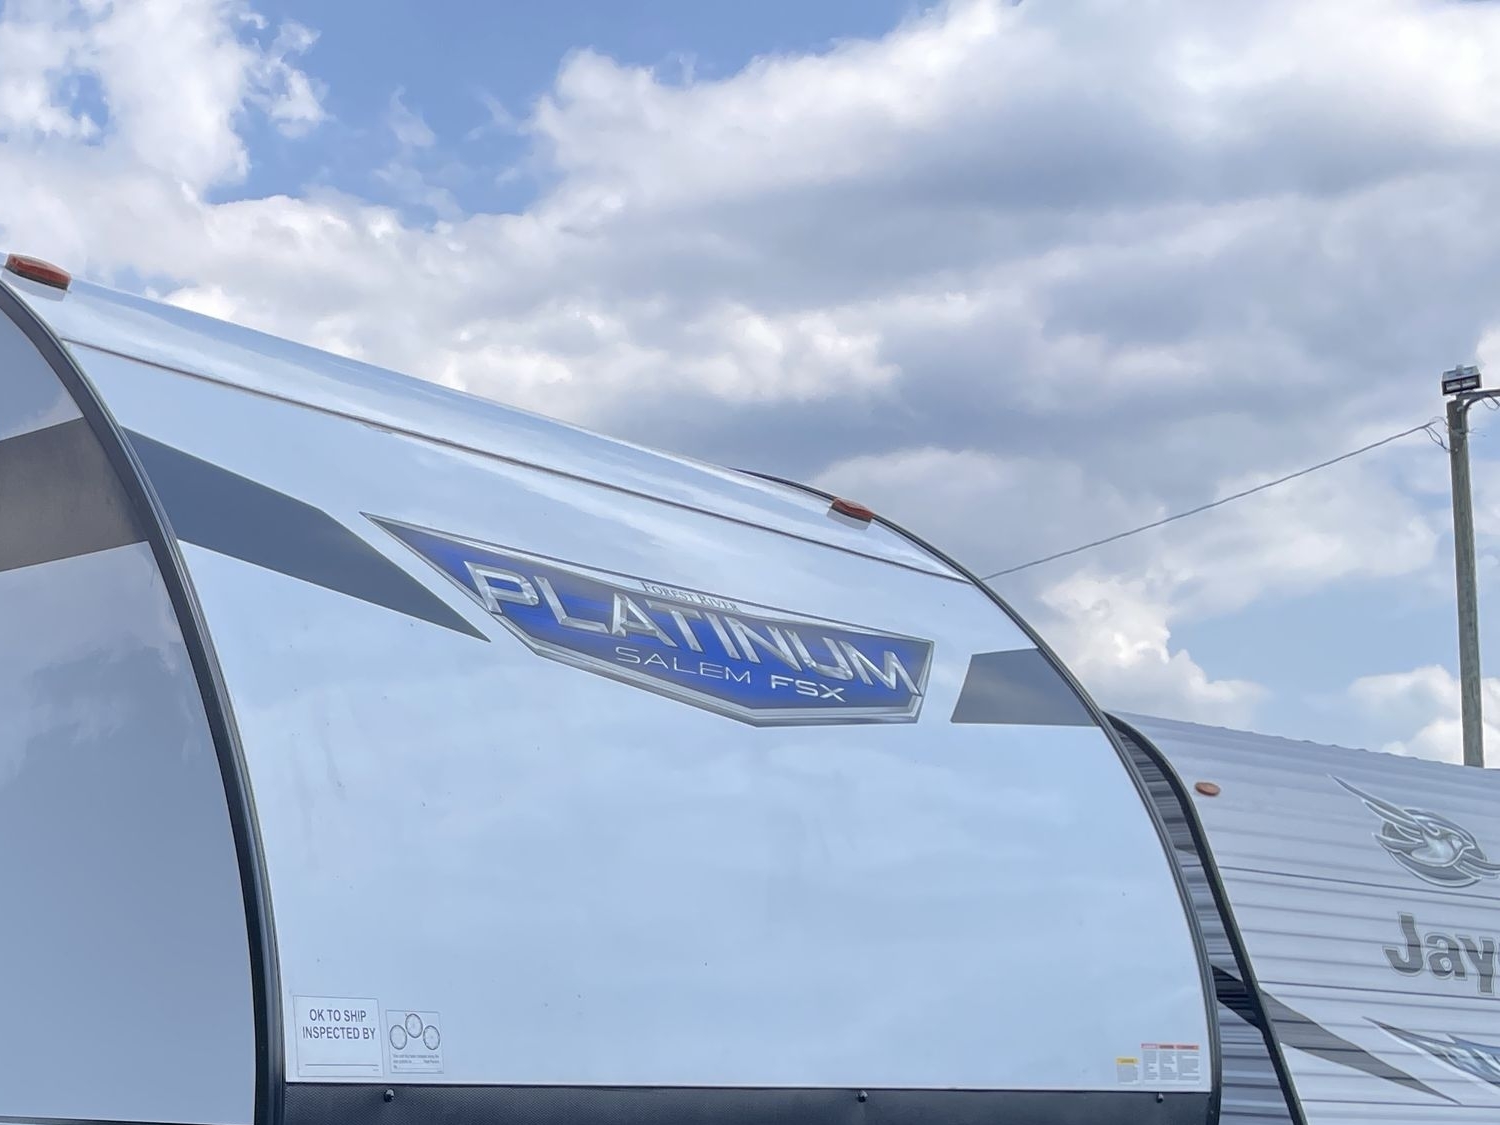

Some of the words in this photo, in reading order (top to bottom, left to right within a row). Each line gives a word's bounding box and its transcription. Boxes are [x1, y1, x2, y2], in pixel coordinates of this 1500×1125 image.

[641, 582, 696, 601] FOREST
[697, 592, 738, 611] RIVER
[464, 561, 923, 697] PLATINUM
[615, 646, 751, 684] SALEM
[770, 674, 846, 702] FSX
[309, 1008, 325, 1022] OK
[326, 1009, 341, 1022] TO
[343, 1009, 367, 1023] SHIP
[302, 1026, 360, 1040] INSPECTED
[362, 1027, 376, 1040] BY
